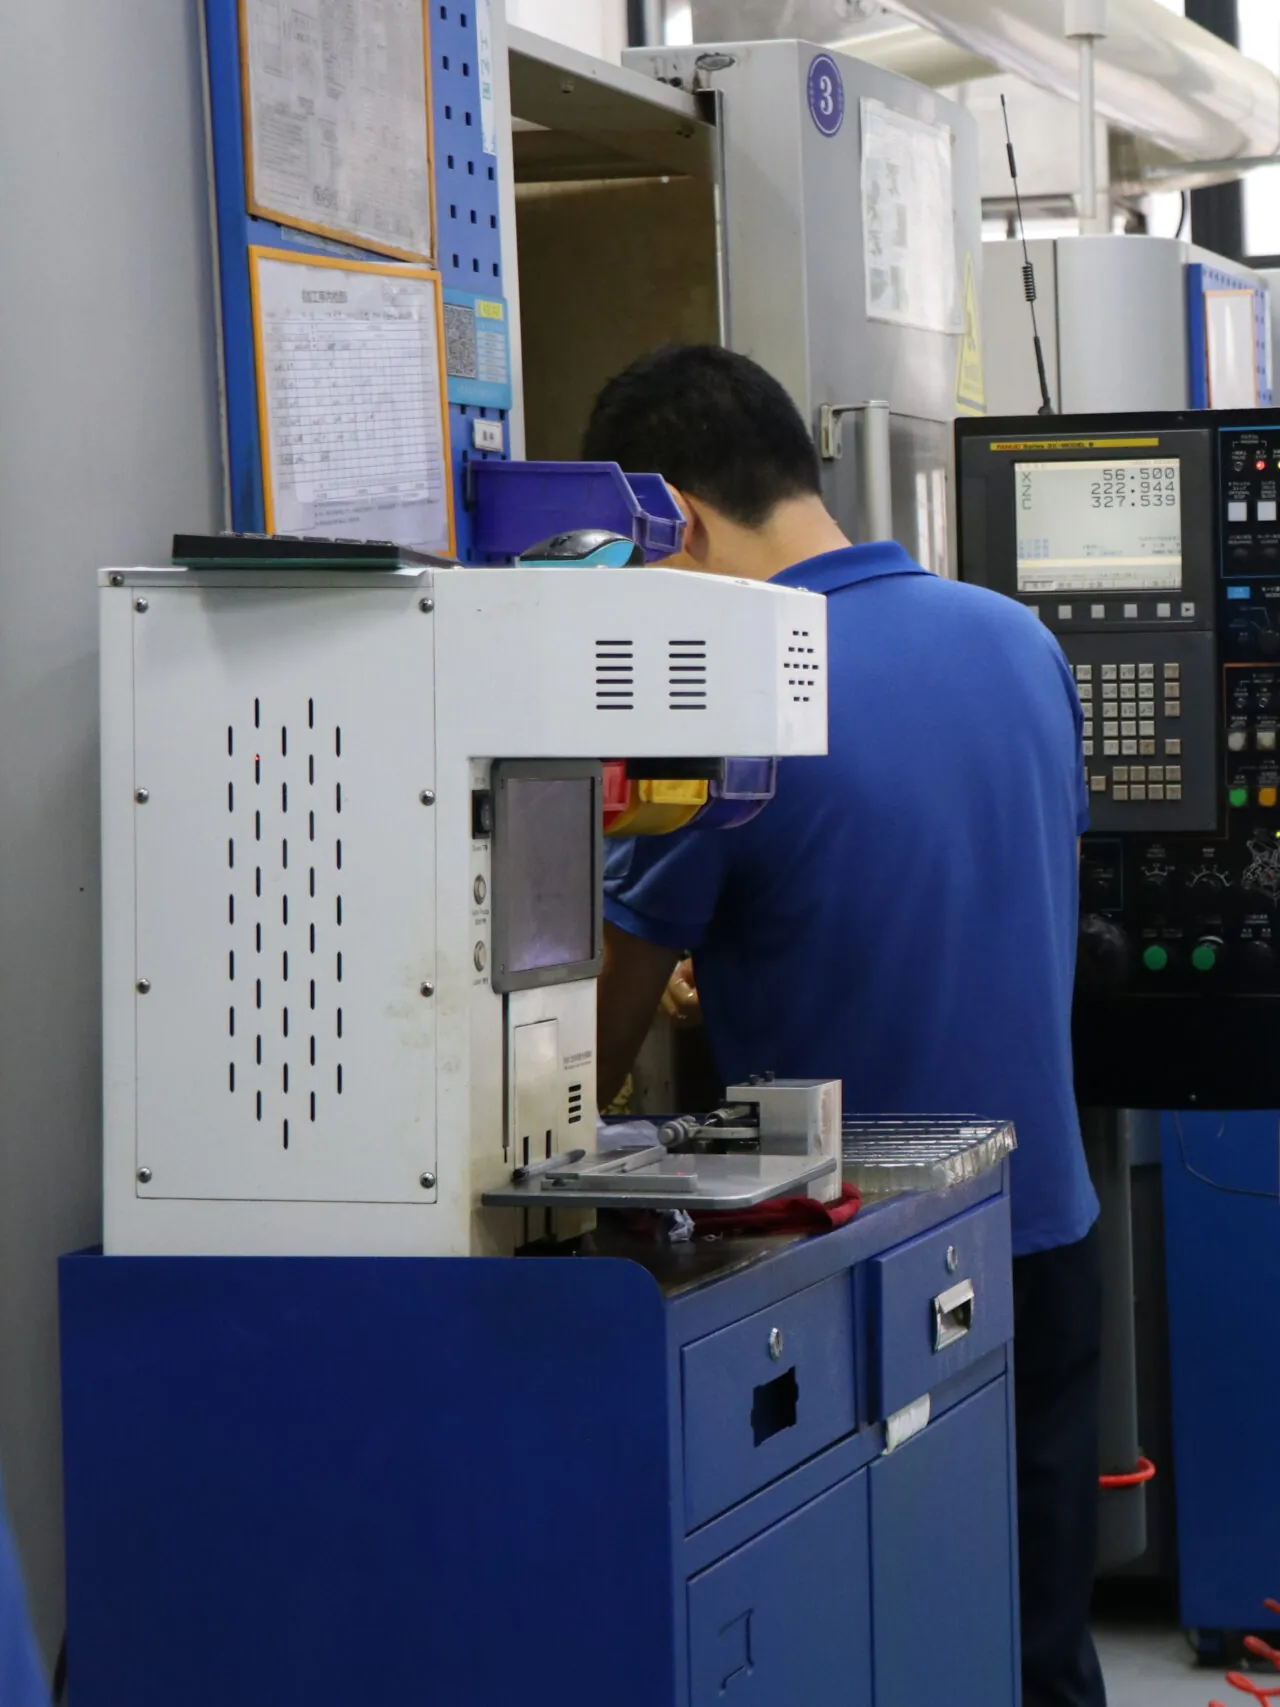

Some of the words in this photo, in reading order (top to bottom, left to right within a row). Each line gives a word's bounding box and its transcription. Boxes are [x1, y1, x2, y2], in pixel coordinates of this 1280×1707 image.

[820, 75, 833, 115] 3
[1022, 471, 1031, 482] X
[1103, 467, 1175, 481] 56.500
[1022, 484, 1031, 497] Z
[1091, 481, 1175, 495] 222.944
[1091, 494, 1176, 508] 327.539
